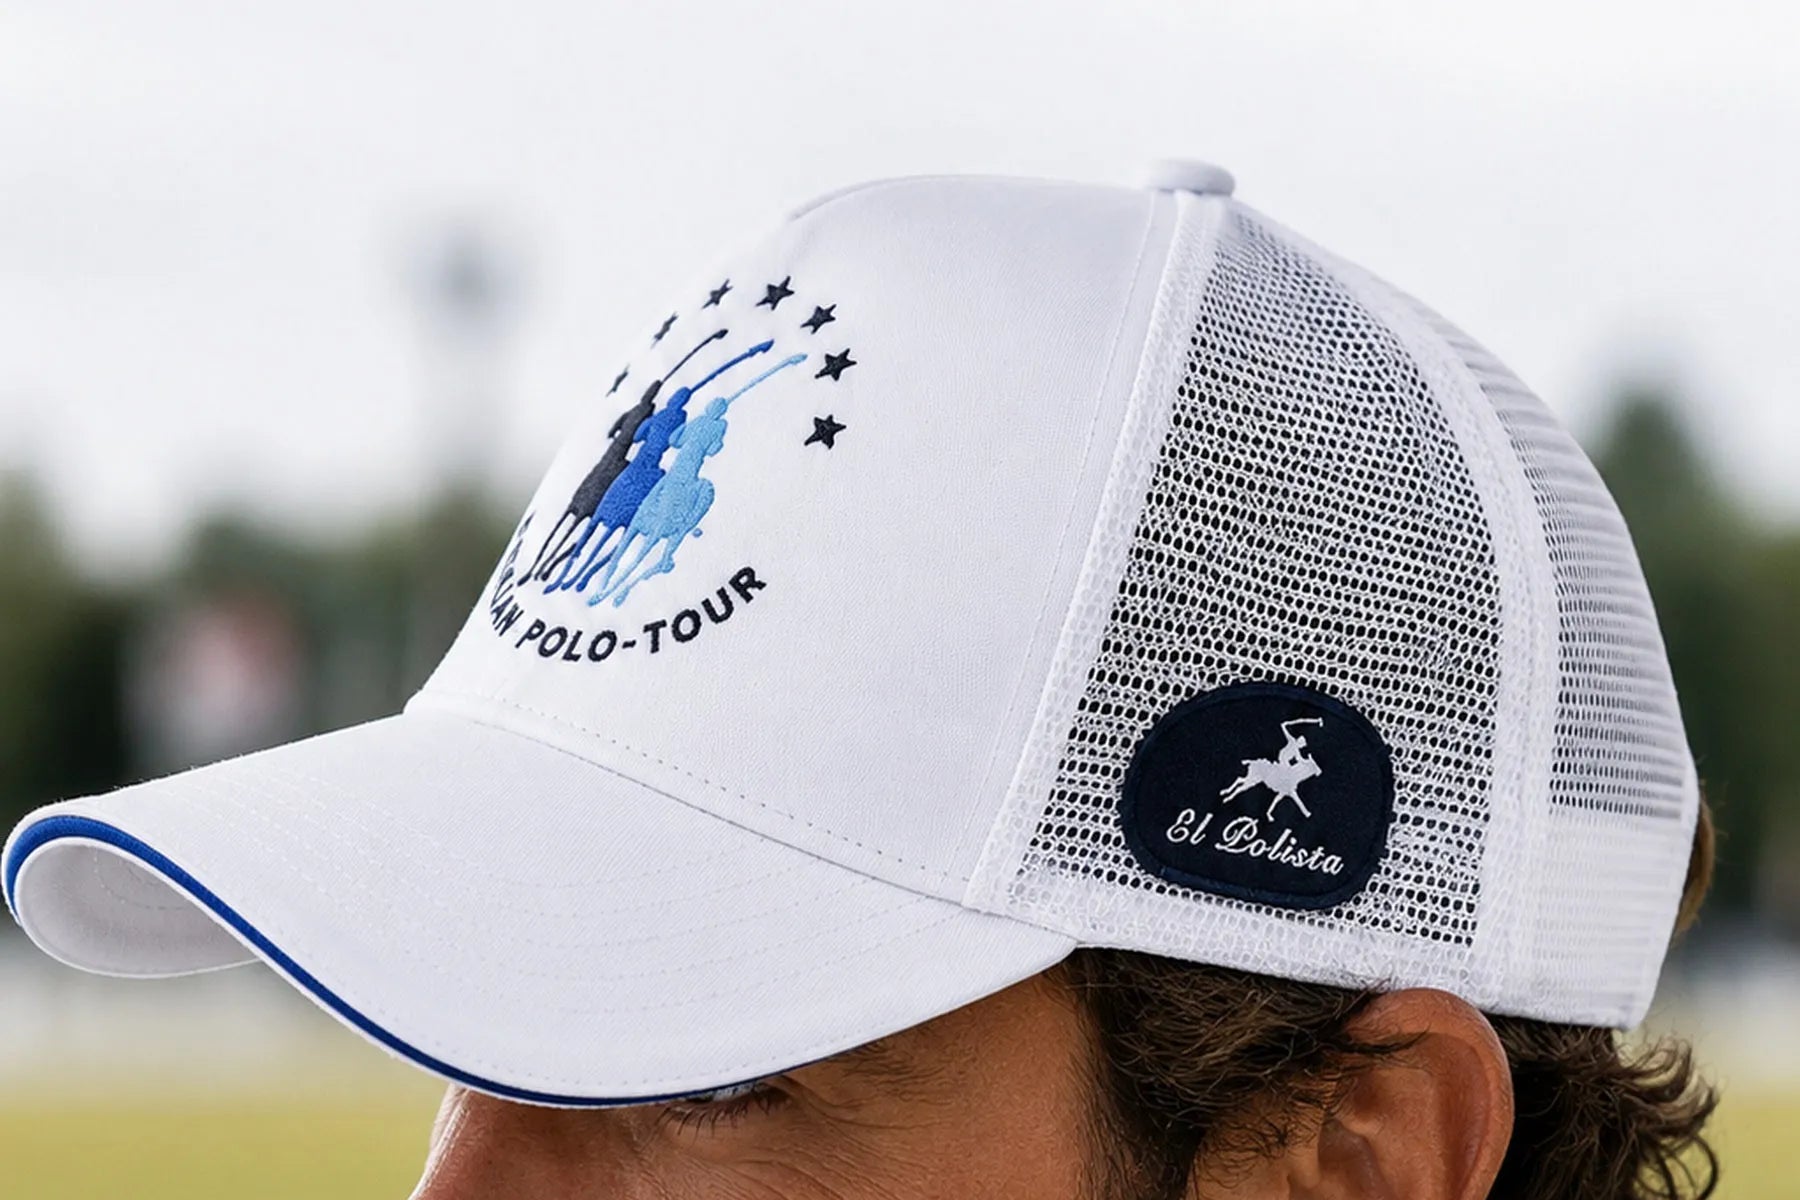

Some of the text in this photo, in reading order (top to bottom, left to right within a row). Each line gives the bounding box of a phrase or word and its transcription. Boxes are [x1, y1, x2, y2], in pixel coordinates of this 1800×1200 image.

[514, 566, 767, 663] POLO-TOUR
[1166, 808, 1345, 876] El Polista
